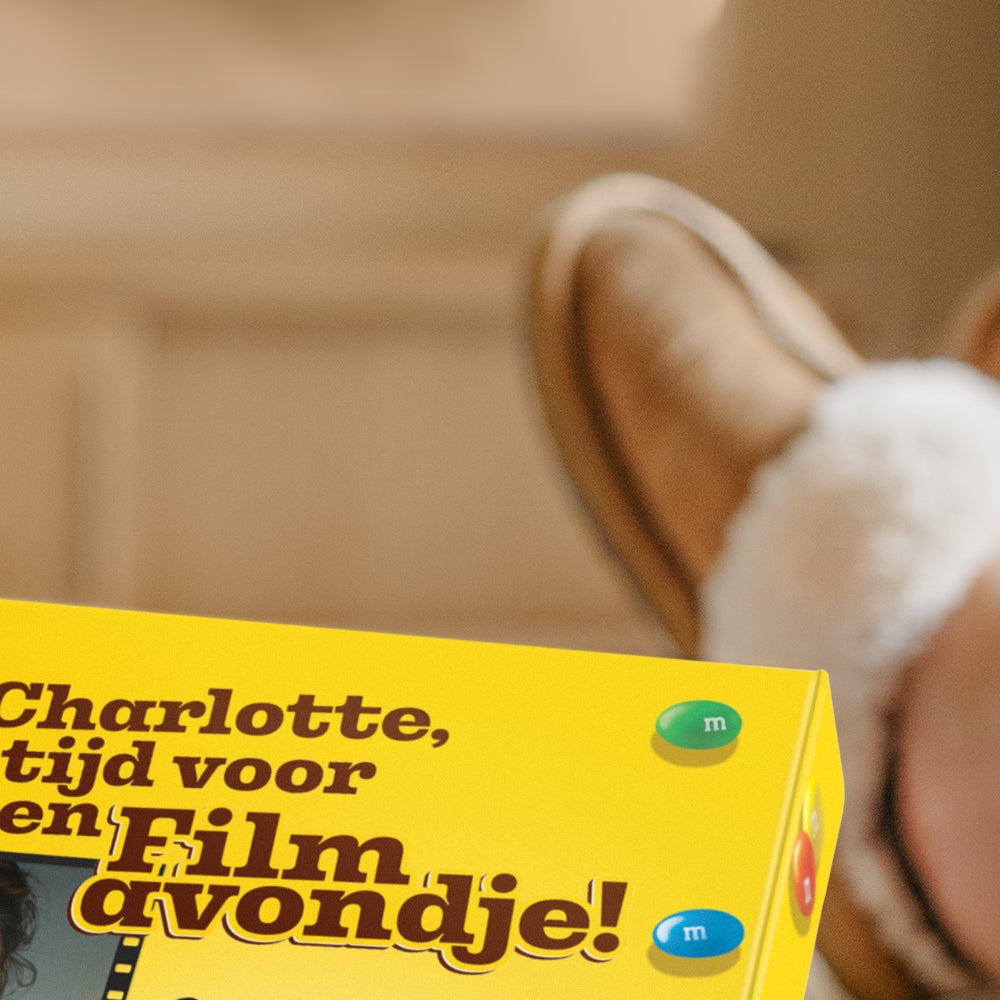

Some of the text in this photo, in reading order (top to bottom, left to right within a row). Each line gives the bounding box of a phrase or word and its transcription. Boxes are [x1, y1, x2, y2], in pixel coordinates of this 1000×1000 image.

[703, 715, 727, 732] m
[0, 735, 377, 798] tijd voor
[103, 804, 411, 886] Film
[73, 871, 631, 968] avondje!
[683, 924, 708, 942] m
